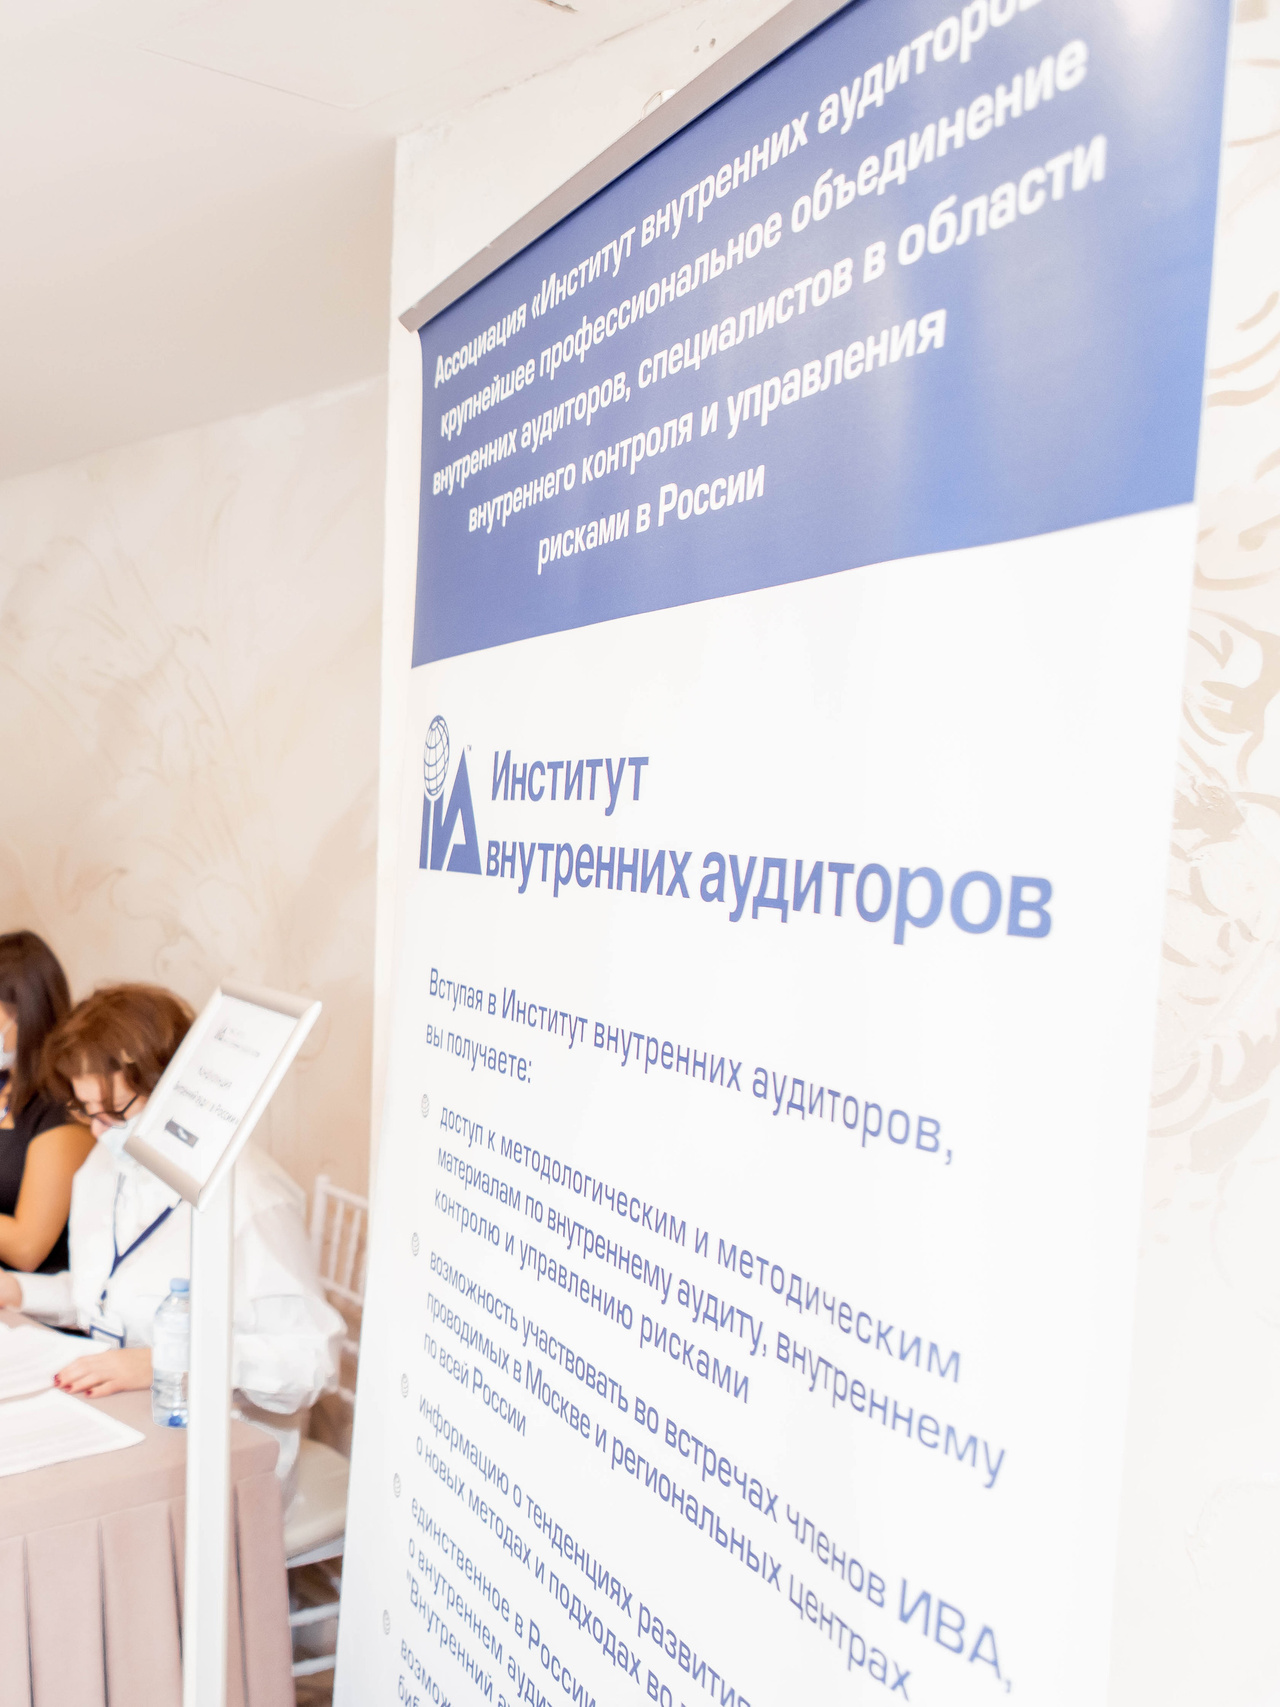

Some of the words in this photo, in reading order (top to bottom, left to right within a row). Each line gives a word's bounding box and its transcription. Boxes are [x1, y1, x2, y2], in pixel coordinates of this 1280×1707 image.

[434, 302, 528, 389] Ассоциация
[530, 225, 637, 320] «Институт
[640, 110, 810, 248] внутренних
[817, 0, 1042, 135] аудиторо
[440, 358, 536, 442] крупнейшее
[539, 211, 783, 381] профессиональное
[791, 40, 1088, 233] объединение
[432, 428, 518, 496] внутренних
[520, 371, 631, 454] аудиторов,
[637, 257, 854, 389] специалистов
[862, 240, 887, 284] в
[897, 134, 1108, 266] области
[468, 462, 577, 535] внутреннего
[581, 411, 694, 485] контроля
[700, 401, 719, 437] и
[726, 308, 947, 440] управления
[536, 508, 630, 576] рисками
[635, 502, 651, 534] в
[657, 464, 766, 528] России
[485, 839, 693, 899] внутренних
[699, 851, 1053, 946] аудиторов
[491, 749, 650, 817] Институт
[425, 1023, 444, 1049] вы
[447, 1032, 533, 1086] получаете:
[429, 967, 484, 1012] Вступая
[487, 992, 497, 1016] в
[501, 986, 589, 1050] Институт
[593, 1021, 743, 1092] внутренних
[752, 1066, 952, 1166] аудиторов,
[434, 1189, 501, 1247] контролю
[504, 1231, 515, 1256] и
[519, 1239, 634, 1331] управлению
[639, 1313, 749, 1405] рисками
[437, 1147, 522, 1212] материалам
[524, 1194, 544, 1224] по
[546, 1206, 673, 1306] внутреннему
[677, 1278, 767, 1358] аудиту,
[776, 1331, 1005, 1489] внутреннему
[439, 1106, 484, 1149] доступ
[487, 1129, 496, 1152] к
[500, 1135, 687, 1247] методологическим
[694, 1227, 709, 1259] и
[717, 1237, 960, 1383] методическим
[424, 1333, 437, 1360] по
[439, 1347, 470, 1388] всей
[472, 1366, 527, 1437] России
[427, 1292, 511, 1375] проводимых
[512, 1358, 523, 1384] в
[525, 1359, 591, 1440] Москве
[594, 1423, 608, 1454] и
[610, 1435, 782, 1593] региональных
[788, 1573, 911, 1701] центрах
[430, 1251, 519, 1332] возможность
[522, 1313, 629, 1413] участвовать
[633, 1395, 660, 1435] во
[664, 1417, 779, 1524] встречах
[786, 1503, 886, 1609] членов
[898, 1577, 1013, 1695] ИВА,
[411, 1497, 510, 1622] единственное
[514, 1611, 524, 1639] в
[418, 1550, 503, 1665] внутреннем
[419, 1396, 509, 1496] информацию
[512, 1483, 522, 1508] о
[525, 1494, 634, 1619] тенденциях
[425, 1449, 466, 1501] новых
[468, 1488, 532, 1571] методах
[534, 1555, 545, 1585] и
[548, 1570, 642, 1686] подходах
